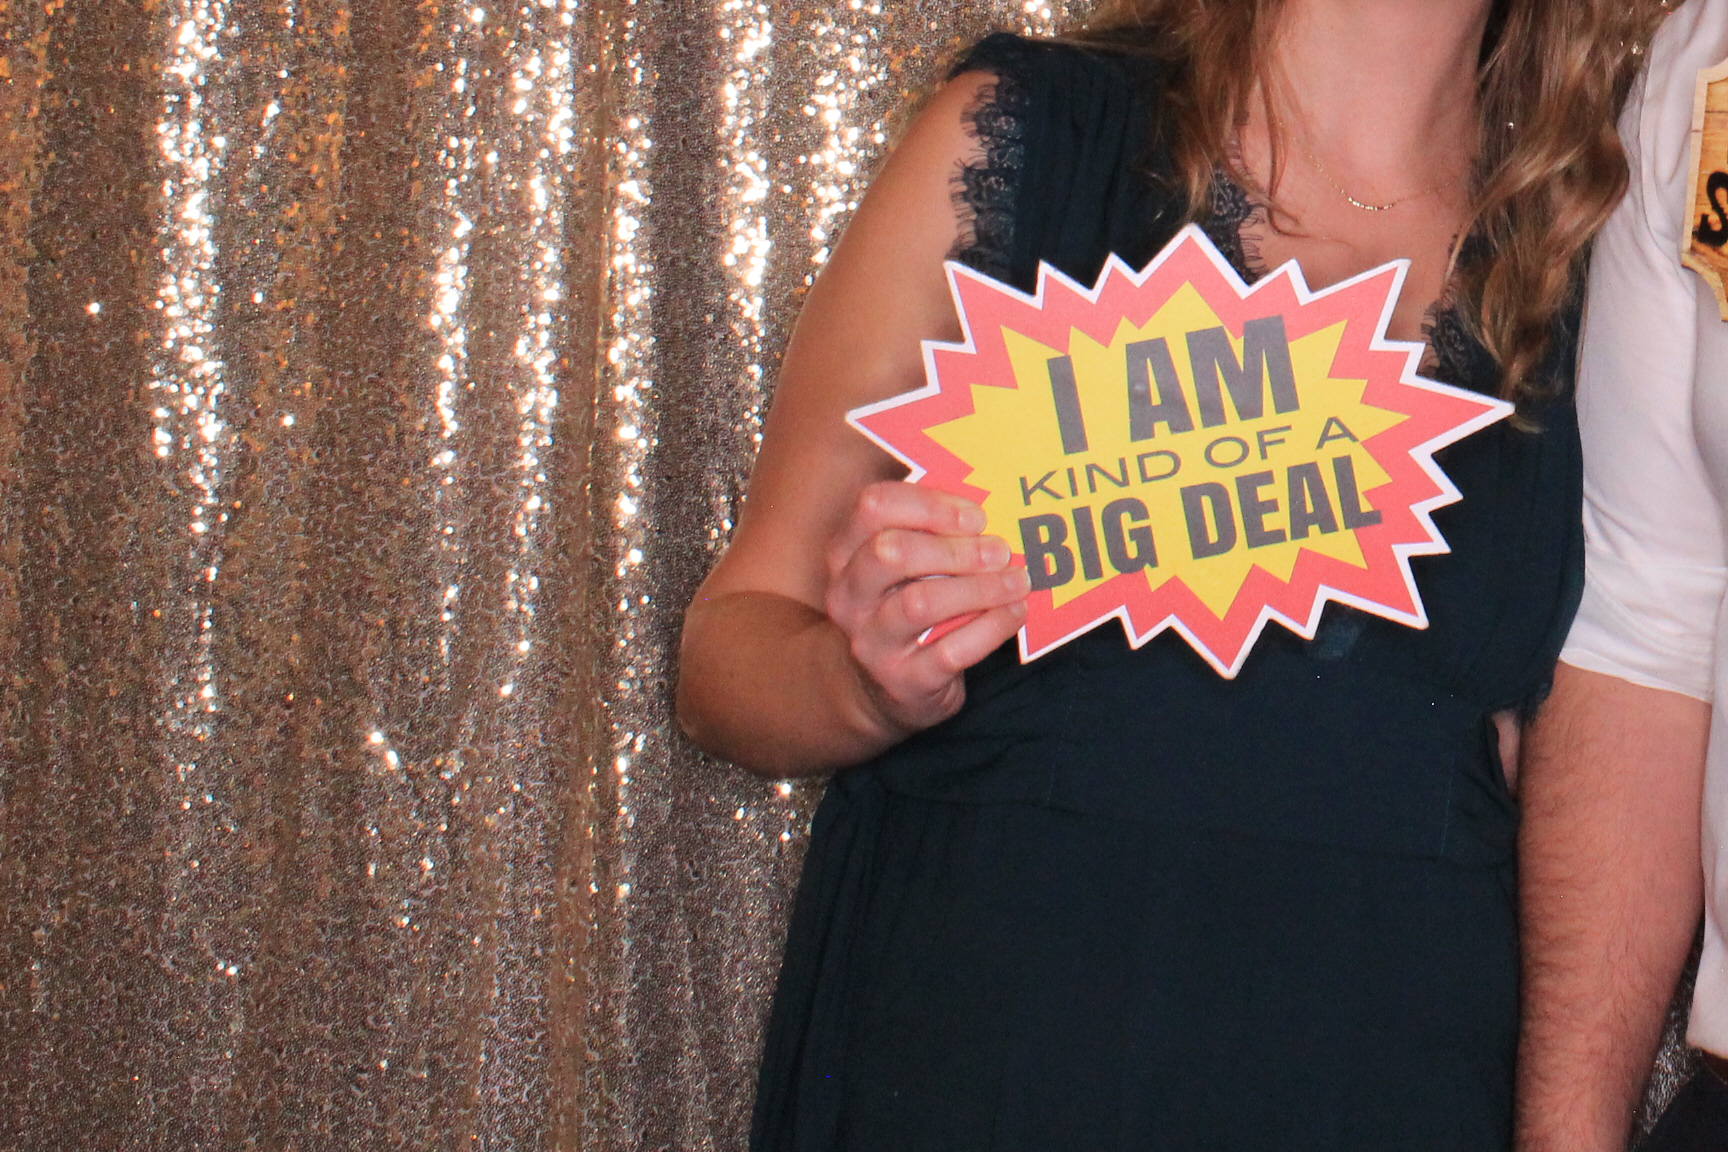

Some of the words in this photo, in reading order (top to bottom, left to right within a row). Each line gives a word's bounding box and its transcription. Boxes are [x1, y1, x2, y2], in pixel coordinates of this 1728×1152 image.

[1046, 354, 1089, 456] I
[1125, 314, 1301, 443] AM
[1017, 497, 1159, 592] BIG
[1180, 454, 1382, 560] DEAL
[1018, 448, 1182, 506] KIND
[1203, 424, 1293, 468] OF
[1313, 416, 1361, 449] A
